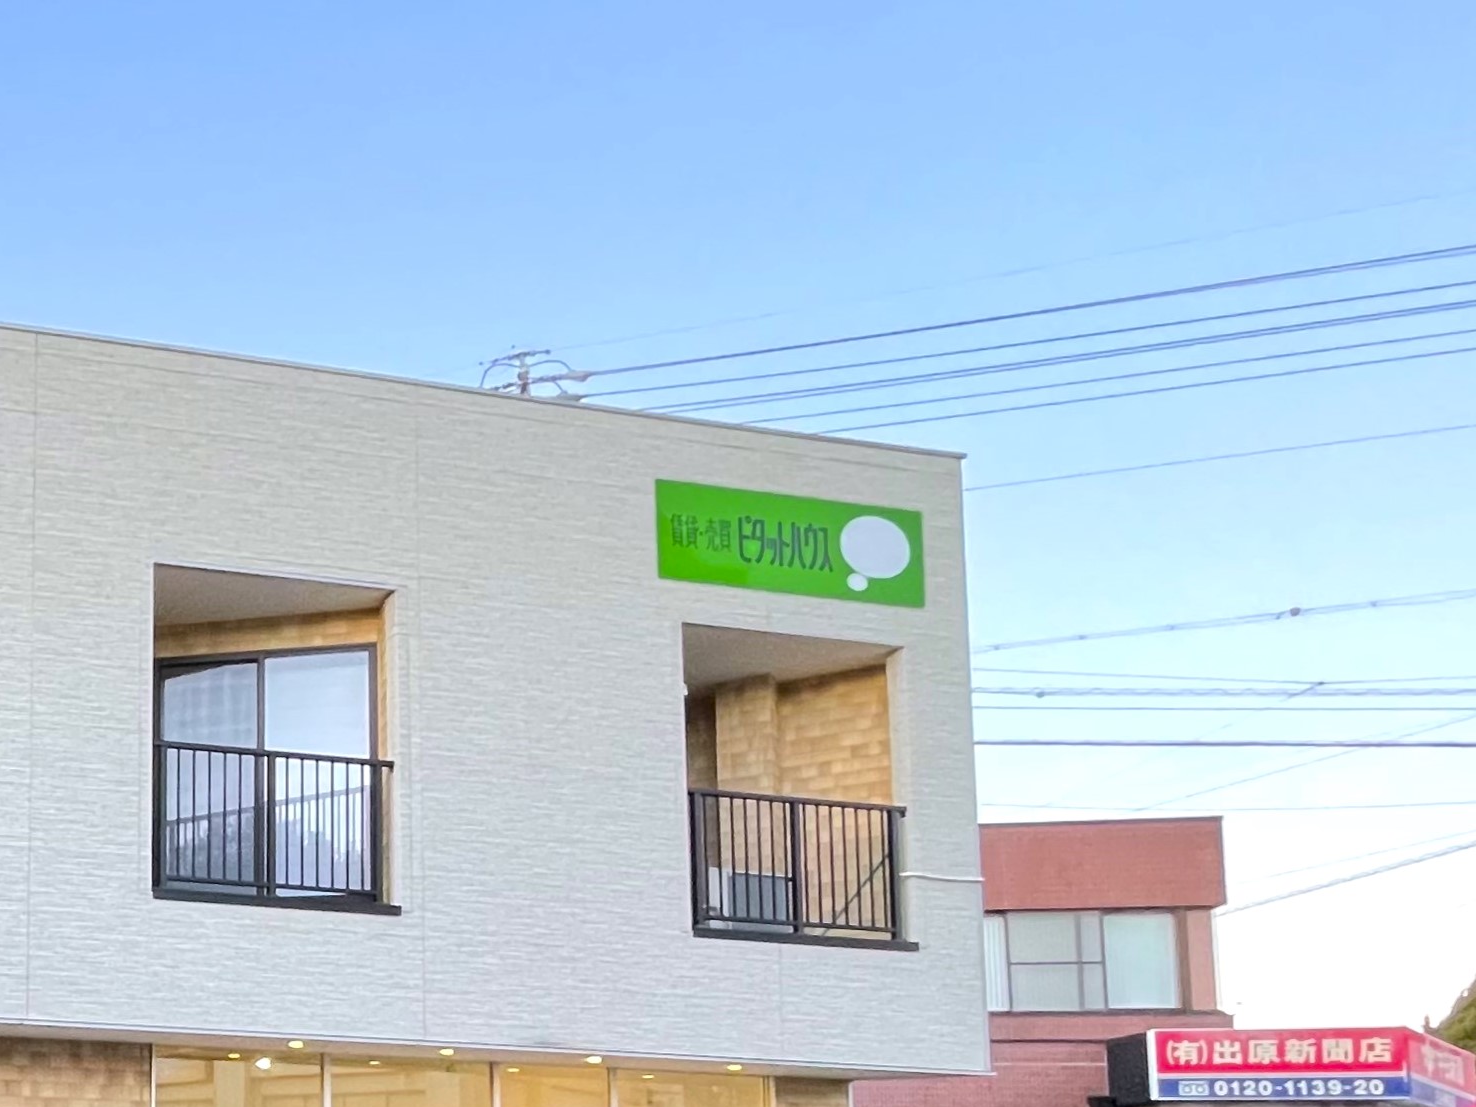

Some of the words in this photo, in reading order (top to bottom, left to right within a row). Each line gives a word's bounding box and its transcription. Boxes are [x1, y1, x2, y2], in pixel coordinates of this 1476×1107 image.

[738, 515, 833, 573] ピタットハウス
[1213, 1079, 1385, 1097] 0120-1139-20
